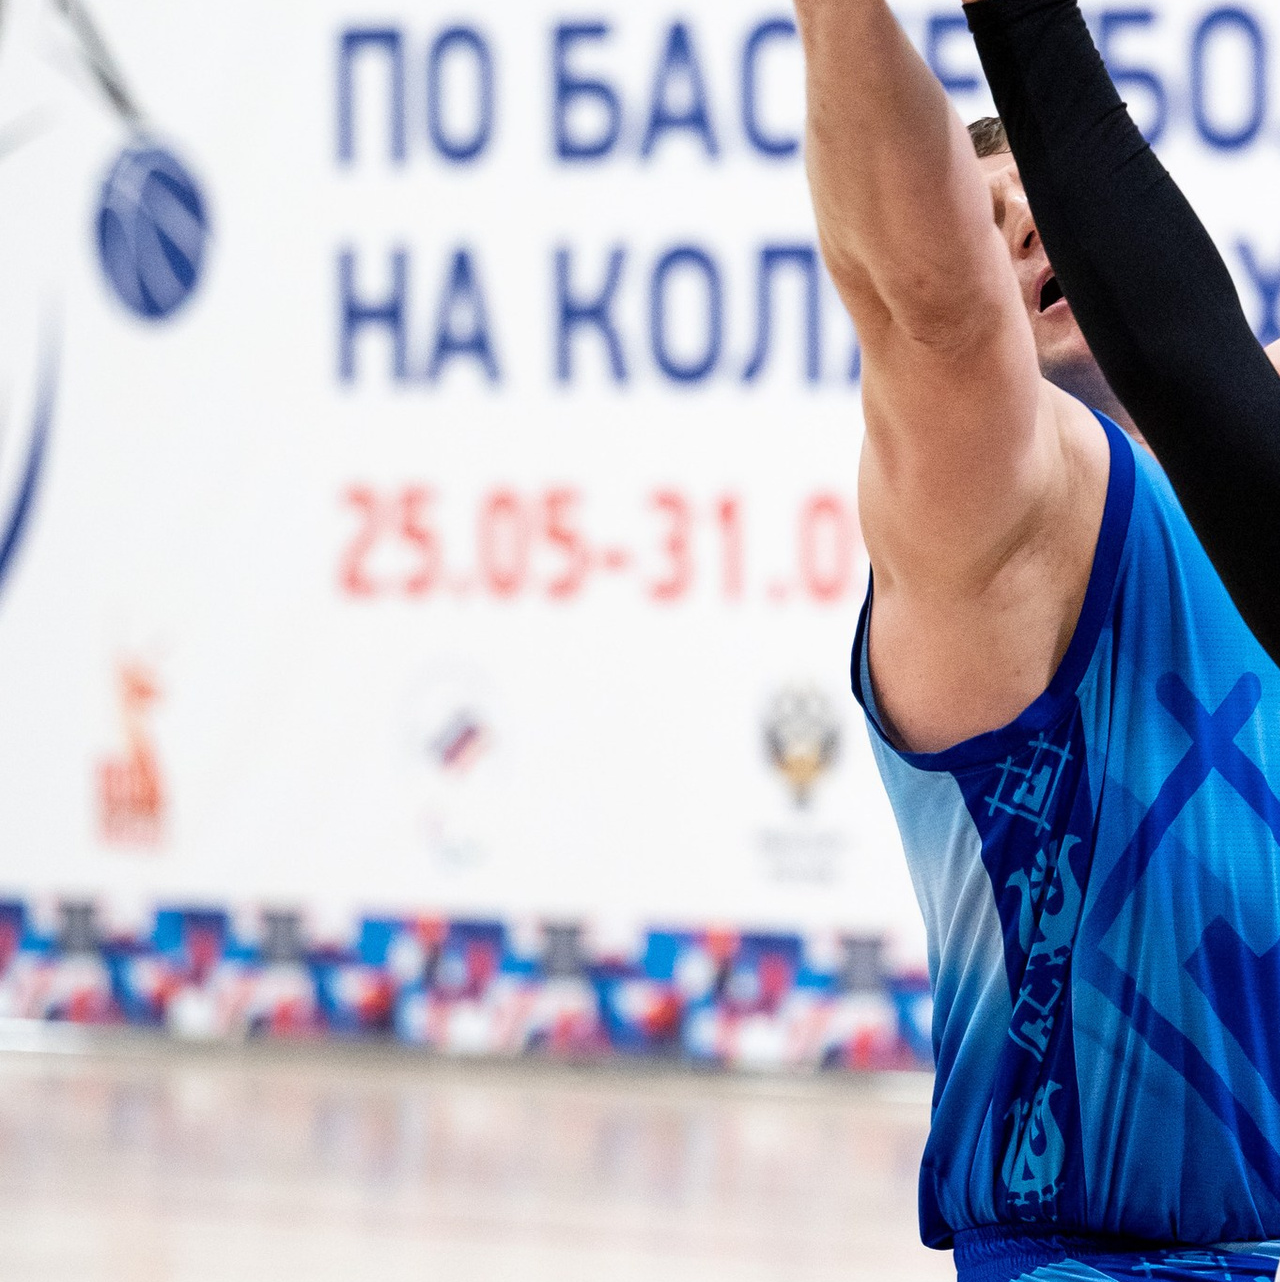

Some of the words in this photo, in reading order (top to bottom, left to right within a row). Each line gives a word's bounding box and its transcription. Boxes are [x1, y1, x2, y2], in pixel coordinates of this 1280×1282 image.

[338, 19, 495, 167] ПО
[338, 241, 500, 387] НА
[336, 483, 860, 603] 25.05-31.0
